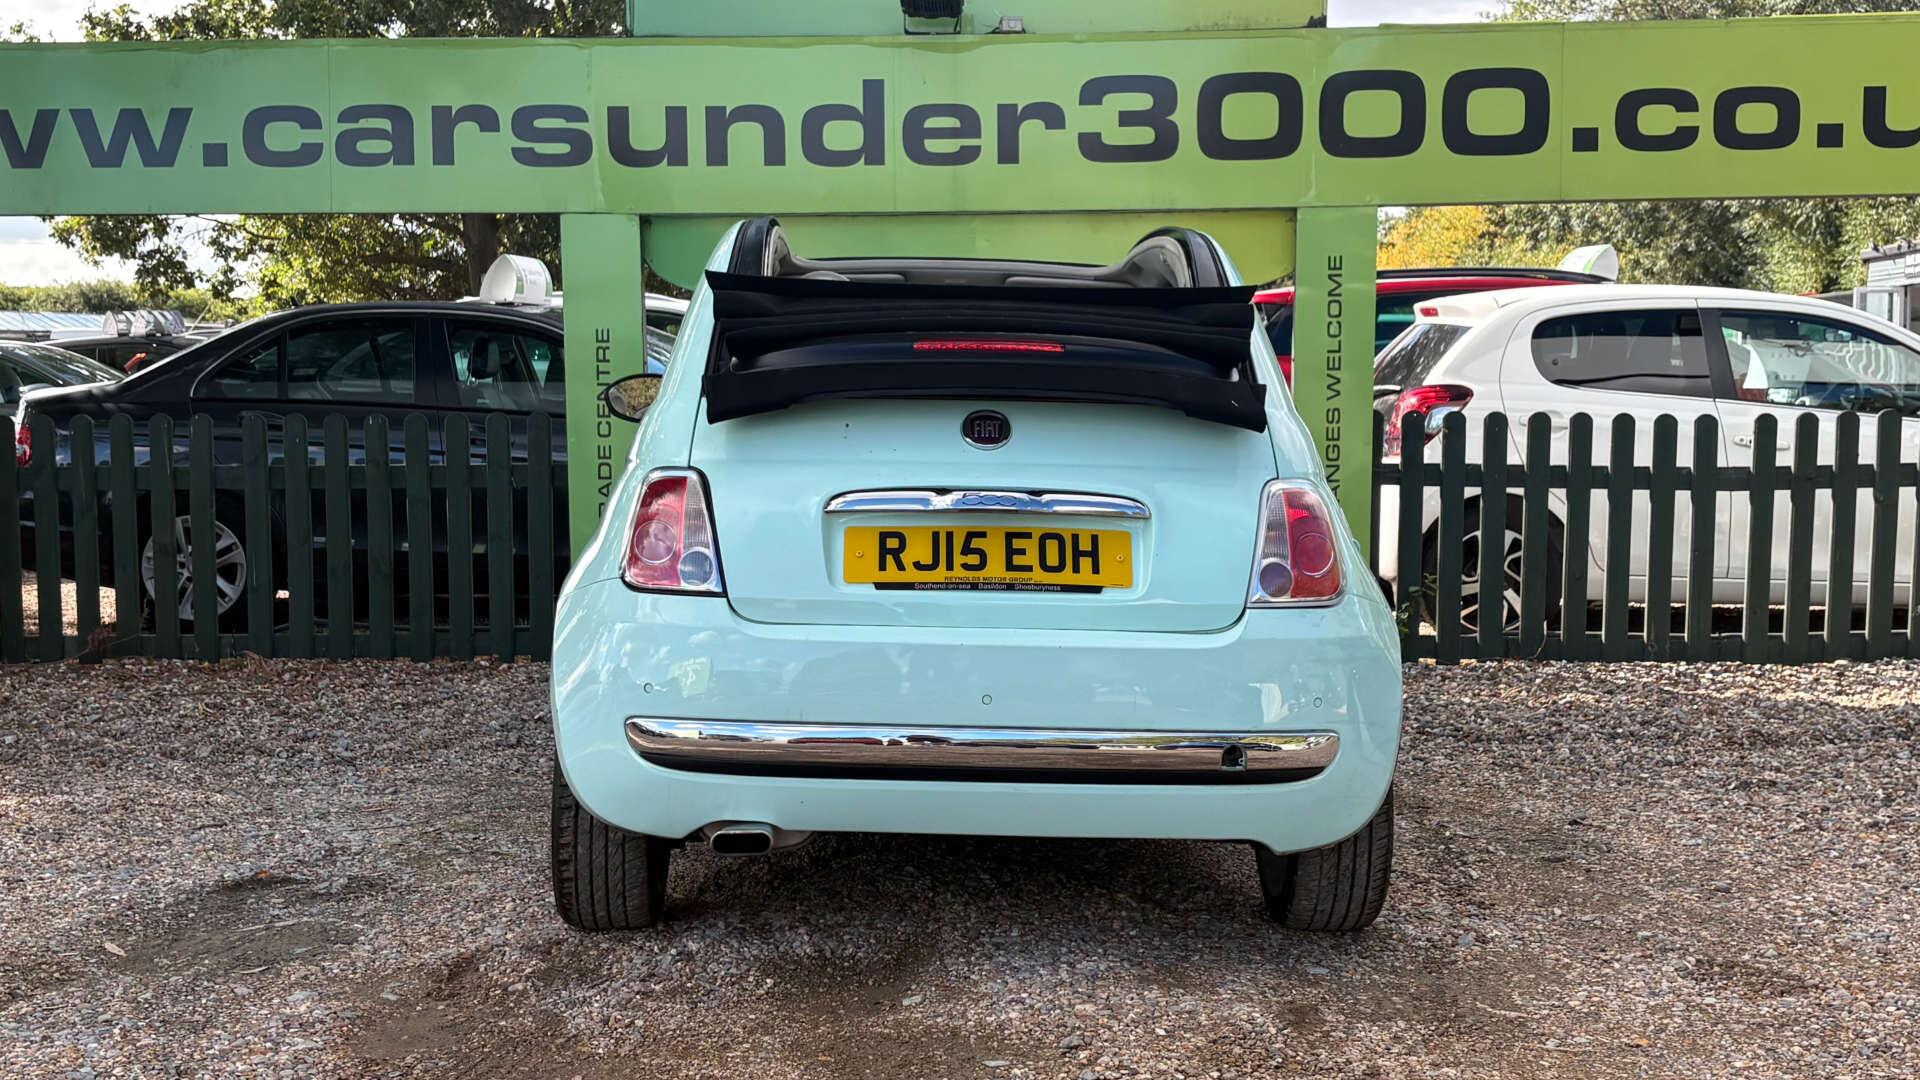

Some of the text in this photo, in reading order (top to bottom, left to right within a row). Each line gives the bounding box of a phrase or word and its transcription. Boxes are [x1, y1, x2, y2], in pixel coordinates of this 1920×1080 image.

[1326, 255, 1343, 401] WELCOME
[974, 420, 1002, 438] FIAT
[878, 530, 1101, 576] RJ15 EOH
[978, 583, 1007, 591] Basildon
